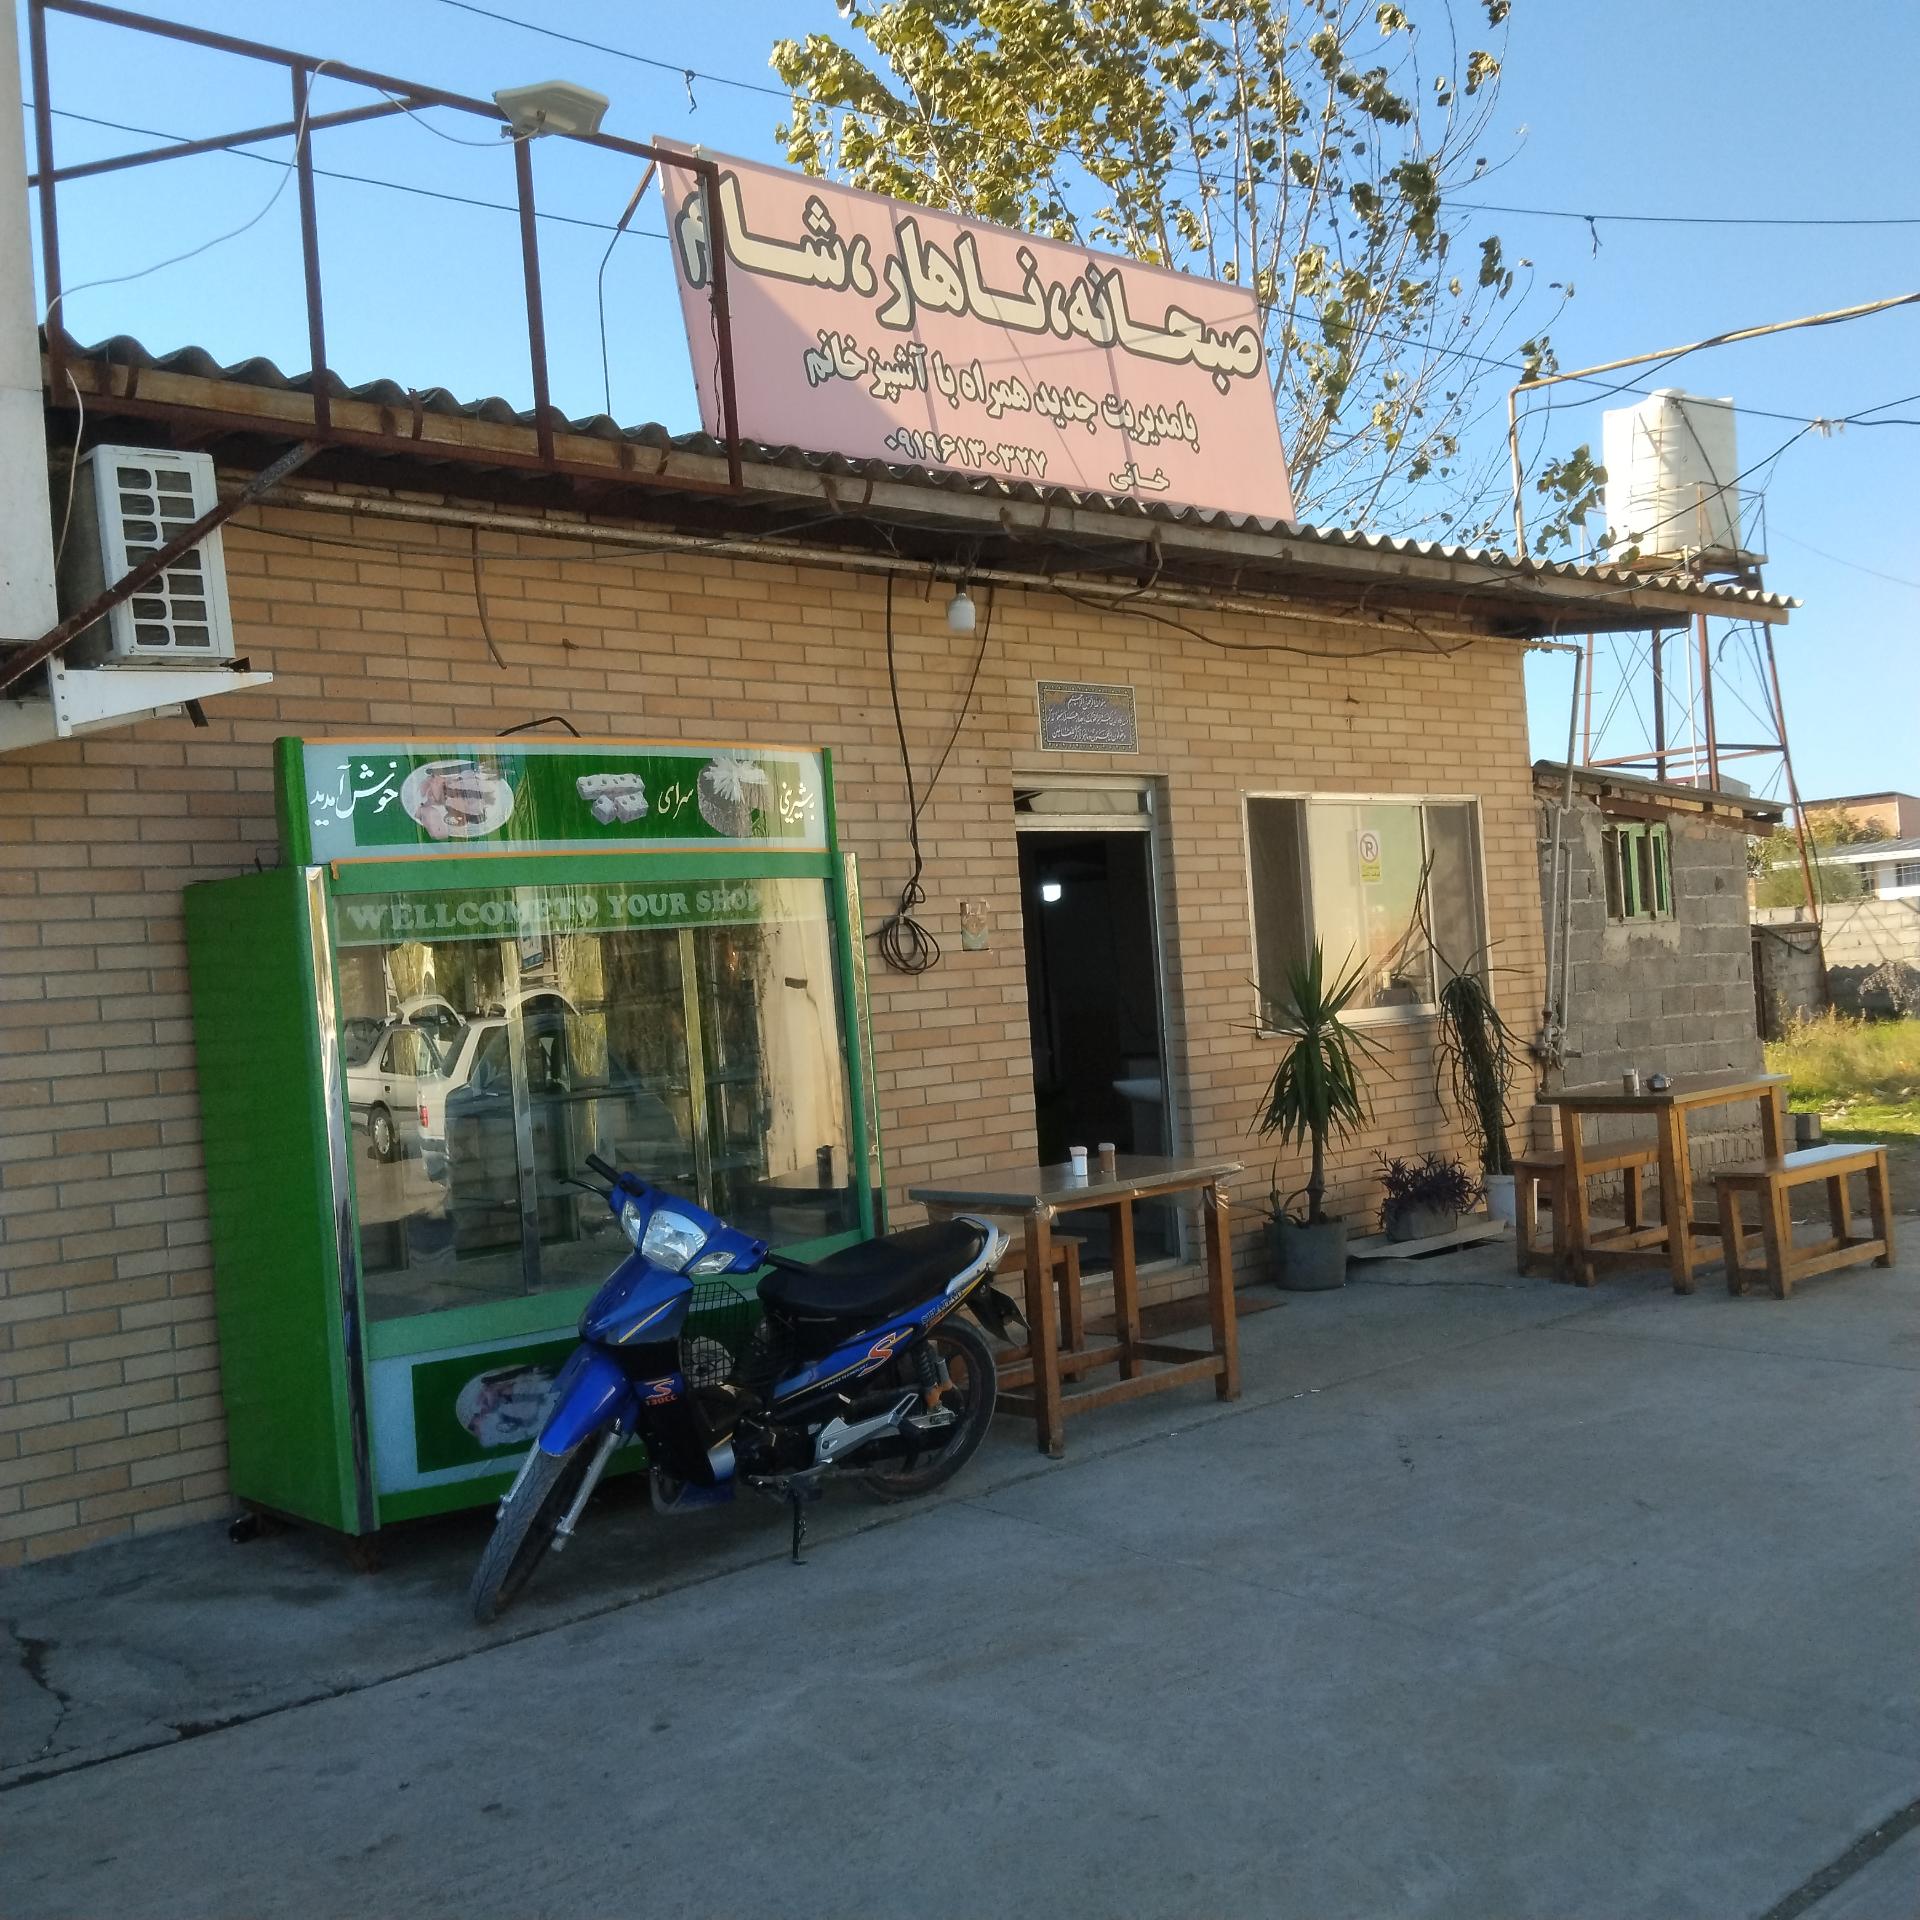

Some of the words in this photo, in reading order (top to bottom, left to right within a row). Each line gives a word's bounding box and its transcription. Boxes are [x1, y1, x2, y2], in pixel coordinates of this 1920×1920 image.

[803, 328, 869, 387] خانم
[869, 341, 928, 404] آشپز
[931, 350, 960, 409] با
[959, 358, 1031, 419] همراه
[1033, 381, 1098, 434] جدید
[884, 427, 1047, 478] ۰۹۱۹۶۱۳۰۳۲۷
[310, 764, 352, 827] آمدید
[335, 761, 399, 819] خوش
[658, 782, 694, 819] سرای
[606, 893, 690, 919] YOUR
[696, 887, 761, 914] SHOP
